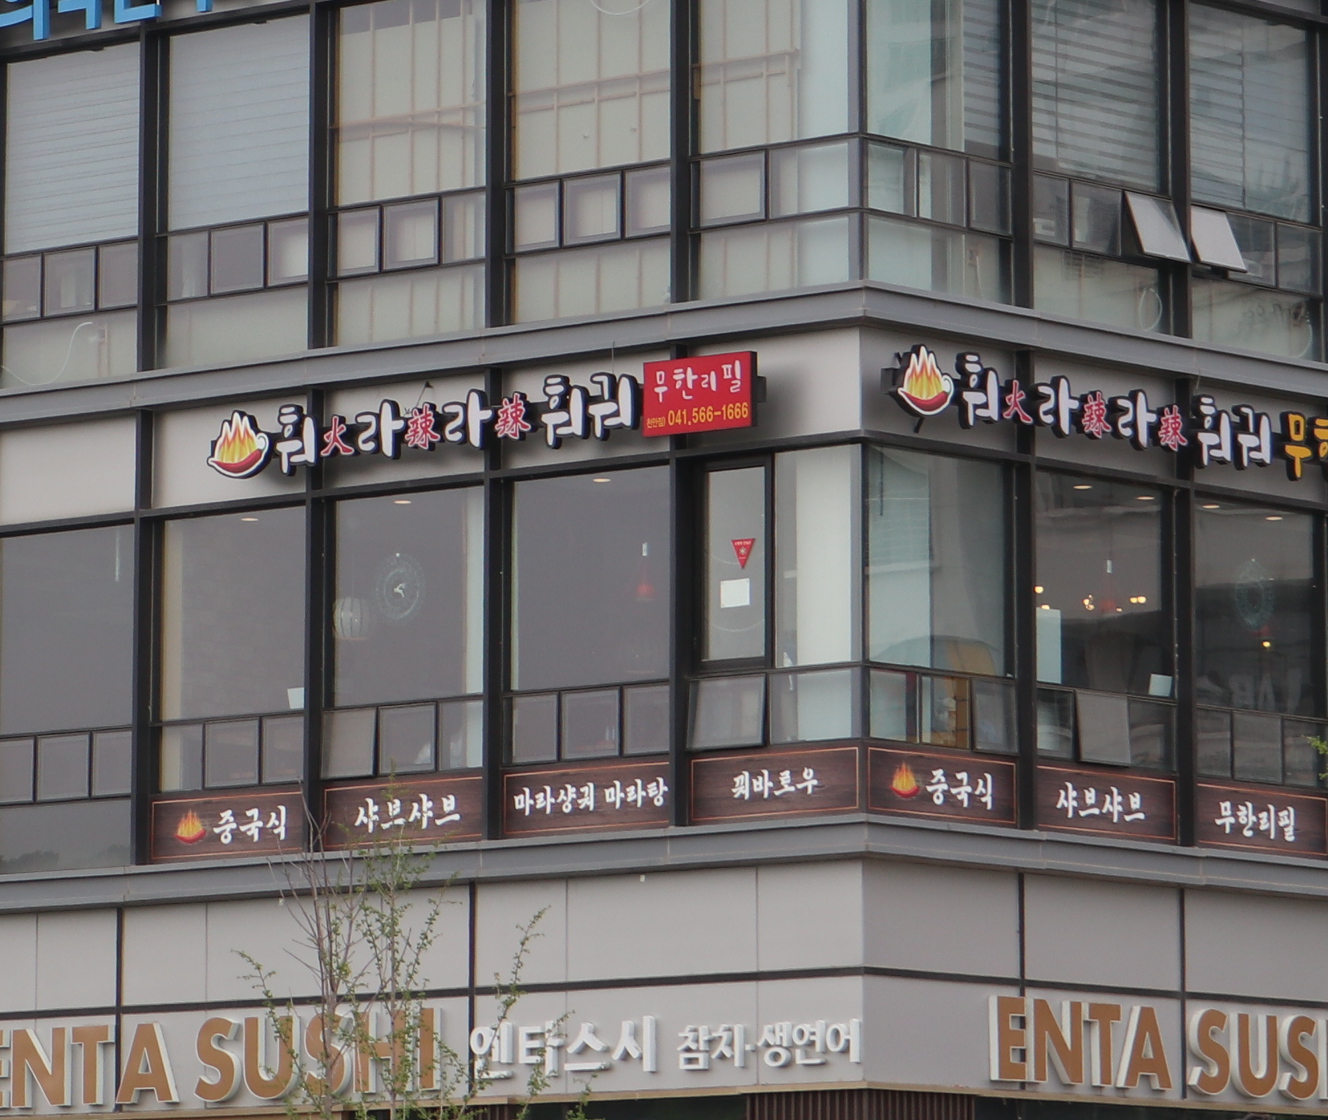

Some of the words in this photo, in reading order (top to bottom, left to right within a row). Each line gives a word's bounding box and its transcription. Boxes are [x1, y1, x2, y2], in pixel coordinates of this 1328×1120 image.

[654, 360, 741, 403] 무한리필
[514, 782, 595, 816] 마라샹궈
[604, 777, 668, 810] 마라탕
[926, 768, 993, 811] 중국식
[1056, 782, 1146, 824] 샤브샤브
[213, 805, 286, 844] 중국식
[355, 795, 460, 834] 샤브샤브
[1215, 801, 1295, 842] 무한리필
[194, 1007, 442, 1103] SUSHI
[471, 1016, 656, 1080] 엔타스시
[989, 995, 1171, 1091] ENTA
